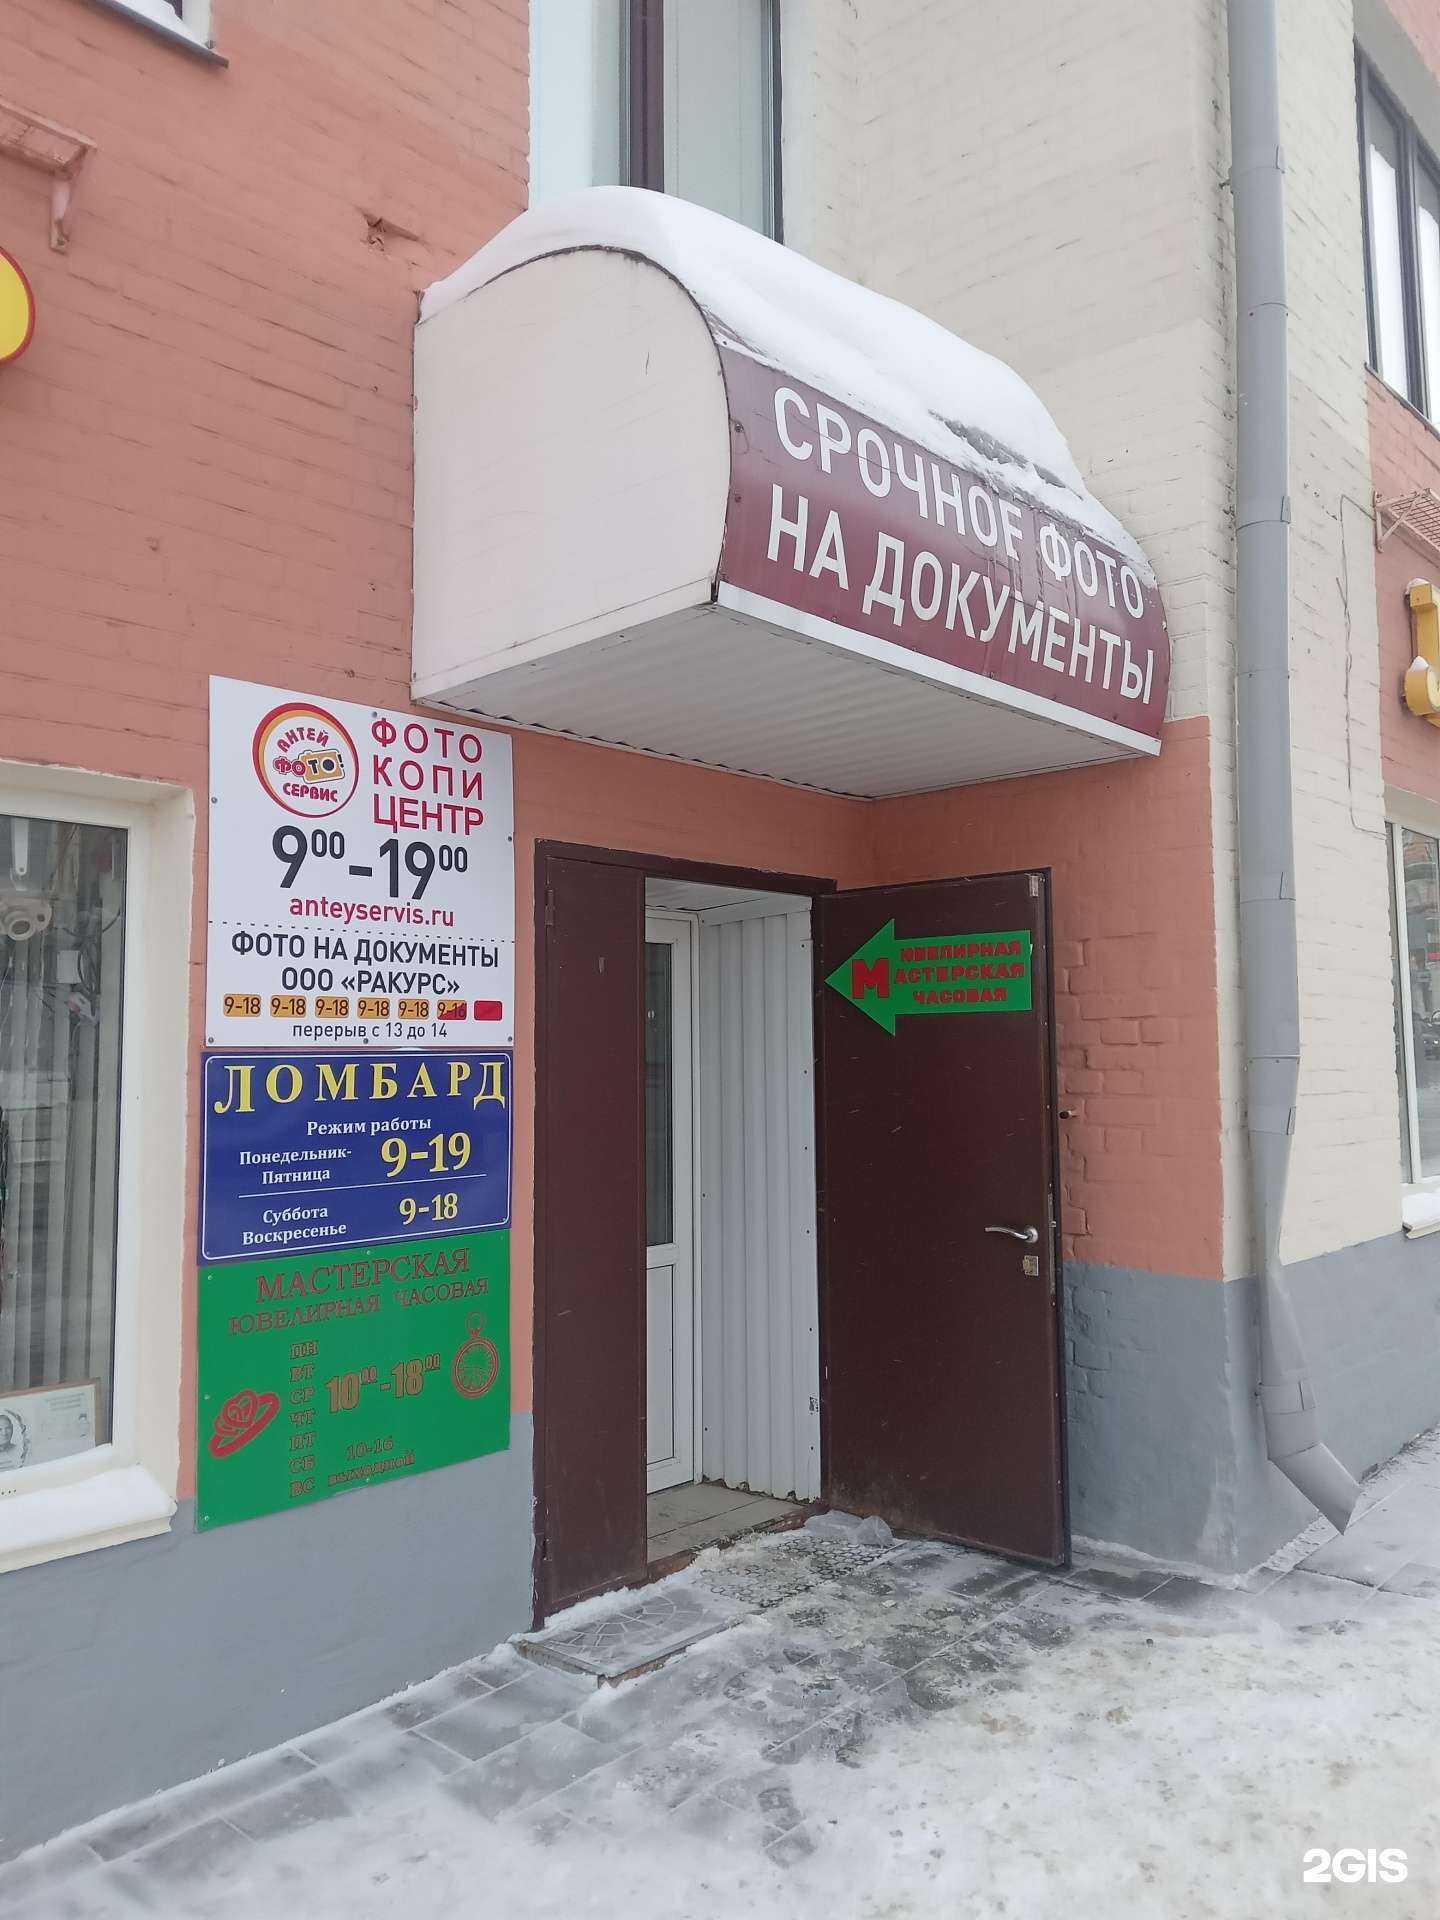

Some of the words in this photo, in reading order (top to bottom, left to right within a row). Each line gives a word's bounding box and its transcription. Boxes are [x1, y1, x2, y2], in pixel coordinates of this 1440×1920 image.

[773, 386, 1024, 560] СРОЧНОЕ
[1039, 523, 1145, 620] ФОТО
[766, 483, 850, 591] НА
[861, 531, 1155, 705] ДОКУМЕНТЫ
[276, 726, 330, 754] АНТЕЙ
[371, 717, 483, 764] ФОТО
[372, 754, 483, 801] КОПИ
[282, 782, 339, 803] СЕРВИС
[373, 793, 484, 836] ЦЕНТР
[289, 896, 454, 927] anteyservis.ru
[231, 930, 305, 958] ФОТО
[313, 936, 349, 961] НА
[353, 939, 499, 968] ДОКУМЕНТЫ
[902, 941, 1021, 961] ЮВЕЛИРНАЯ
[281, 967, 334, 992] ООО
[340, 970, 460, 995] «РАКУРС»
[224, 996, 261, 1016] 9-18
[270, 997, 306, 1016] 9-18
[315, 998, 349, 1017] 9-18
[358, 999, 390, 1018] 9-18
[398, 1000, 430, 1018] 9-18
[913, 988, 1007, 1004] ЧАСОВАЯ
[292, 1023, 366, 1041] перерыв
[372, 1025, 380, 1039] с
[386, 1022, 403, 1038] 13
[406, 1024, 426, 1040] до
[431, 1023, 448, 1038] 14
[213, 1061, 506, 1114] ЛОМБАРД
[307, 1120, 366, 1136] Режим
[370, 1117, 432, 1135] работы
[239, 1147, 352, 1166] Понедельник-
[381, 1132, 472, 1178] 9-19
[262, 1167, 331, 1185] Пятница
[262, 1206, 329, 1226] Суббота
[399, 1193, 459, 1226] 9-18
[242, 1223, 347, 1246] Воскресенье
[256, 1248, 470, 1304] МАСТЕРСКАЯ
[228, 1295, 382, 1337] ЮВЕЛИРНАЯ
[393, 1278, 489, 1309] ЧАСОВАЯ
[290, 1387, 316, 1405] СР
